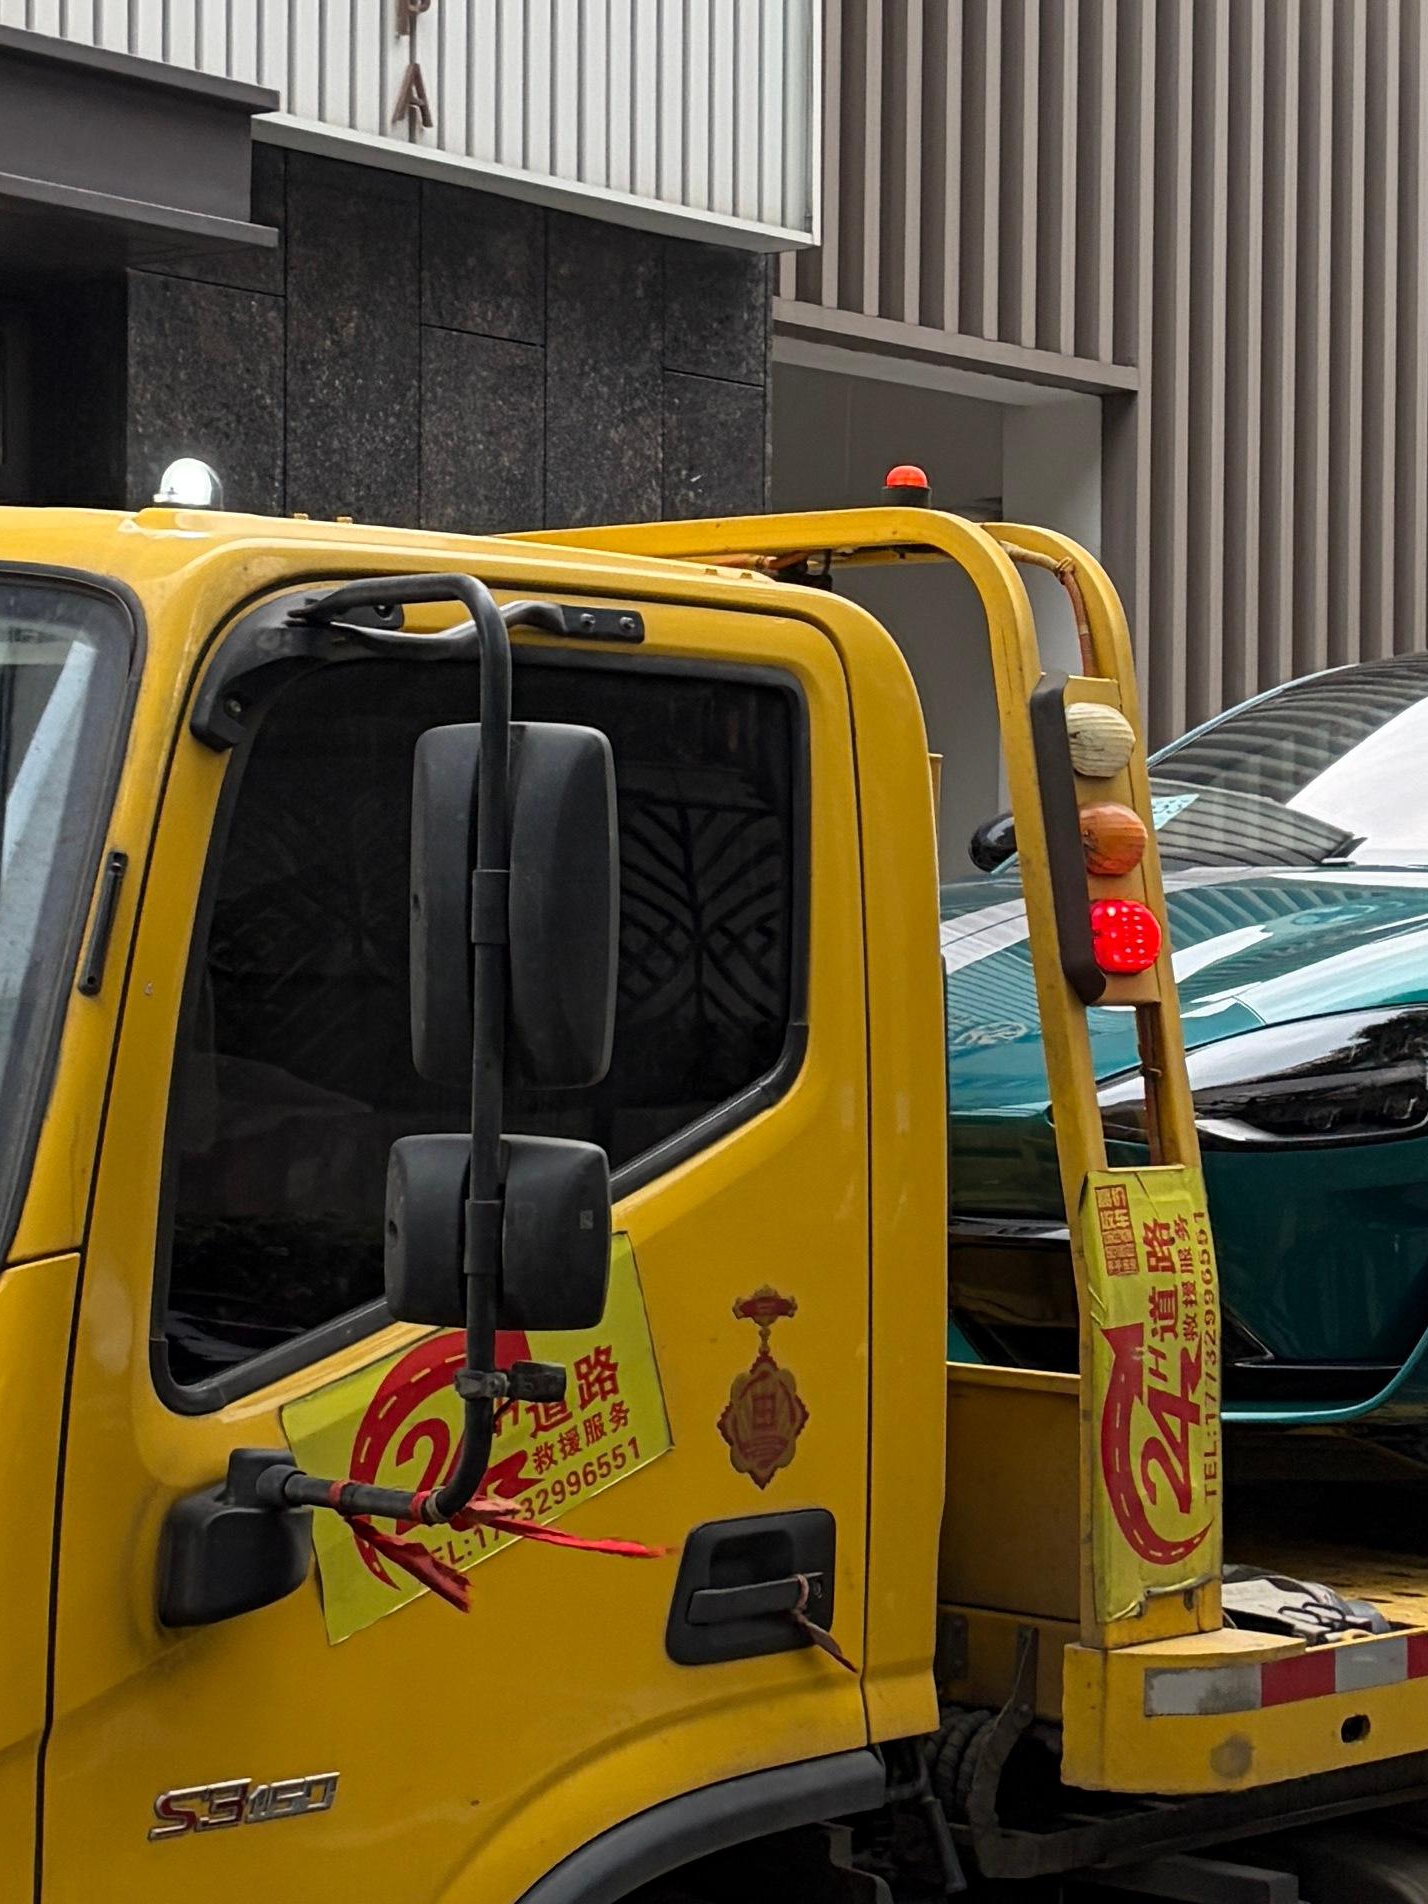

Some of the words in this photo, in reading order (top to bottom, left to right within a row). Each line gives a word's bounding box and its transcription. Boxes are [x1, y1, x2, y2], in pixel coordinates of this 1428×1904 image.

[1142, 1216, 1179, 1343] 道路
[1174, 1213, 1199, 1342] 救援服务
[531, 1400, 630, 1475] 救援服务
